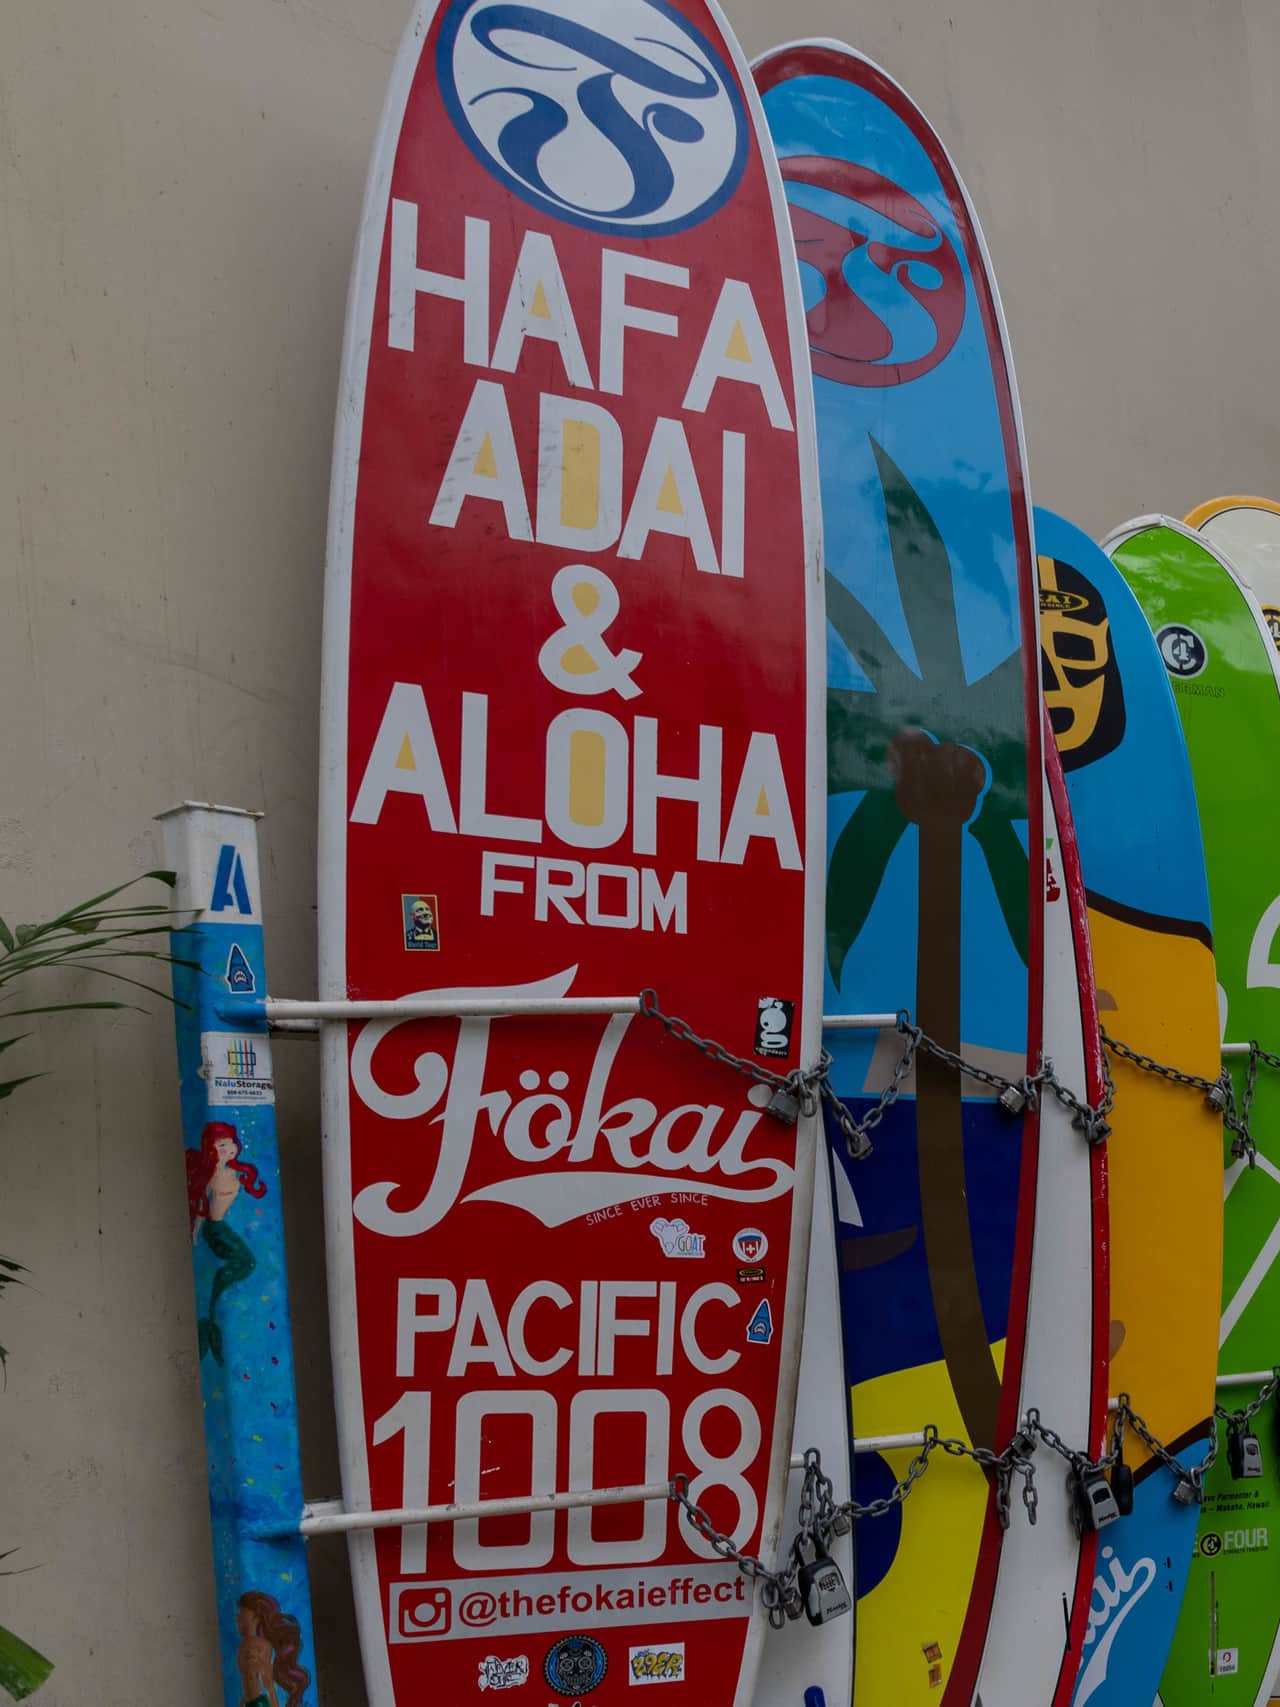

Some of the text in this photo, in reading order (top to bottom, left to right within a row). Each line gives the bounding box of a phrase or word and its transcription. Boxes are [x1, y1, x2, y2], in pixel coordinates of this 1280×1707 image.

[388, 198, 794, 432] HAFA
[429, 379, 746, 579] ADAI
[538, 564, 643, 701] &
[349, 681, 804, 871] ALOHA
[211, 845, 252, 914] A
[480, 850, 688, 934] FROM
[585, 1192, 709, 1226] SINCE EVER SINCE
[677, 1236, 706, 1253] GOAT
[396, 1278, 741, 1378] PACIFIC
[373, 1388, 762, 1575] 1008
[1224, 1528, 1268, 1551] FOUR
[459, 1576, 746, 1628] @thefokaieffect
